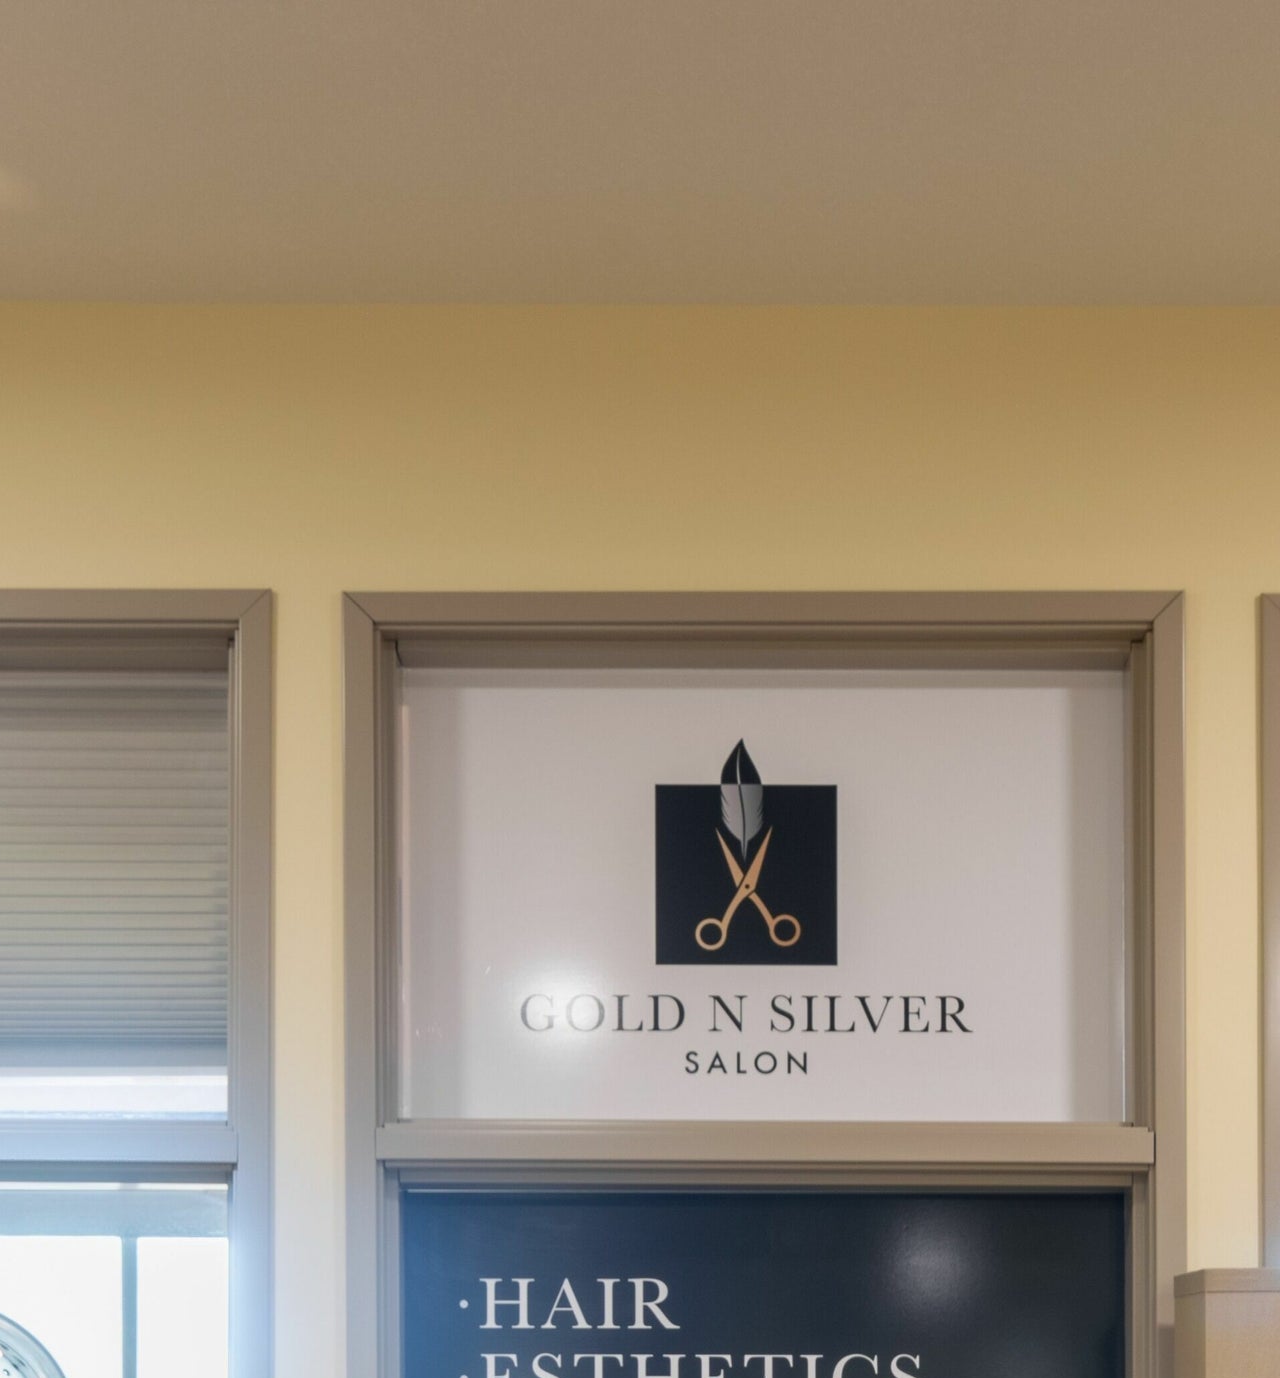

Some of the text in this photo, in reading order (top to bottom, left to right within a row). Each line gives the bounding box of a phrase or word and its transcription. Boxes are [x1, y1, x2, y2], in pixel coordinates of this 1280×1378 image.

[519, 994, 974, 1033] GOLD N SILVER
[684, 1050, 809, 1075] SALON
[478, 1277, 681, 1330] HAIR
